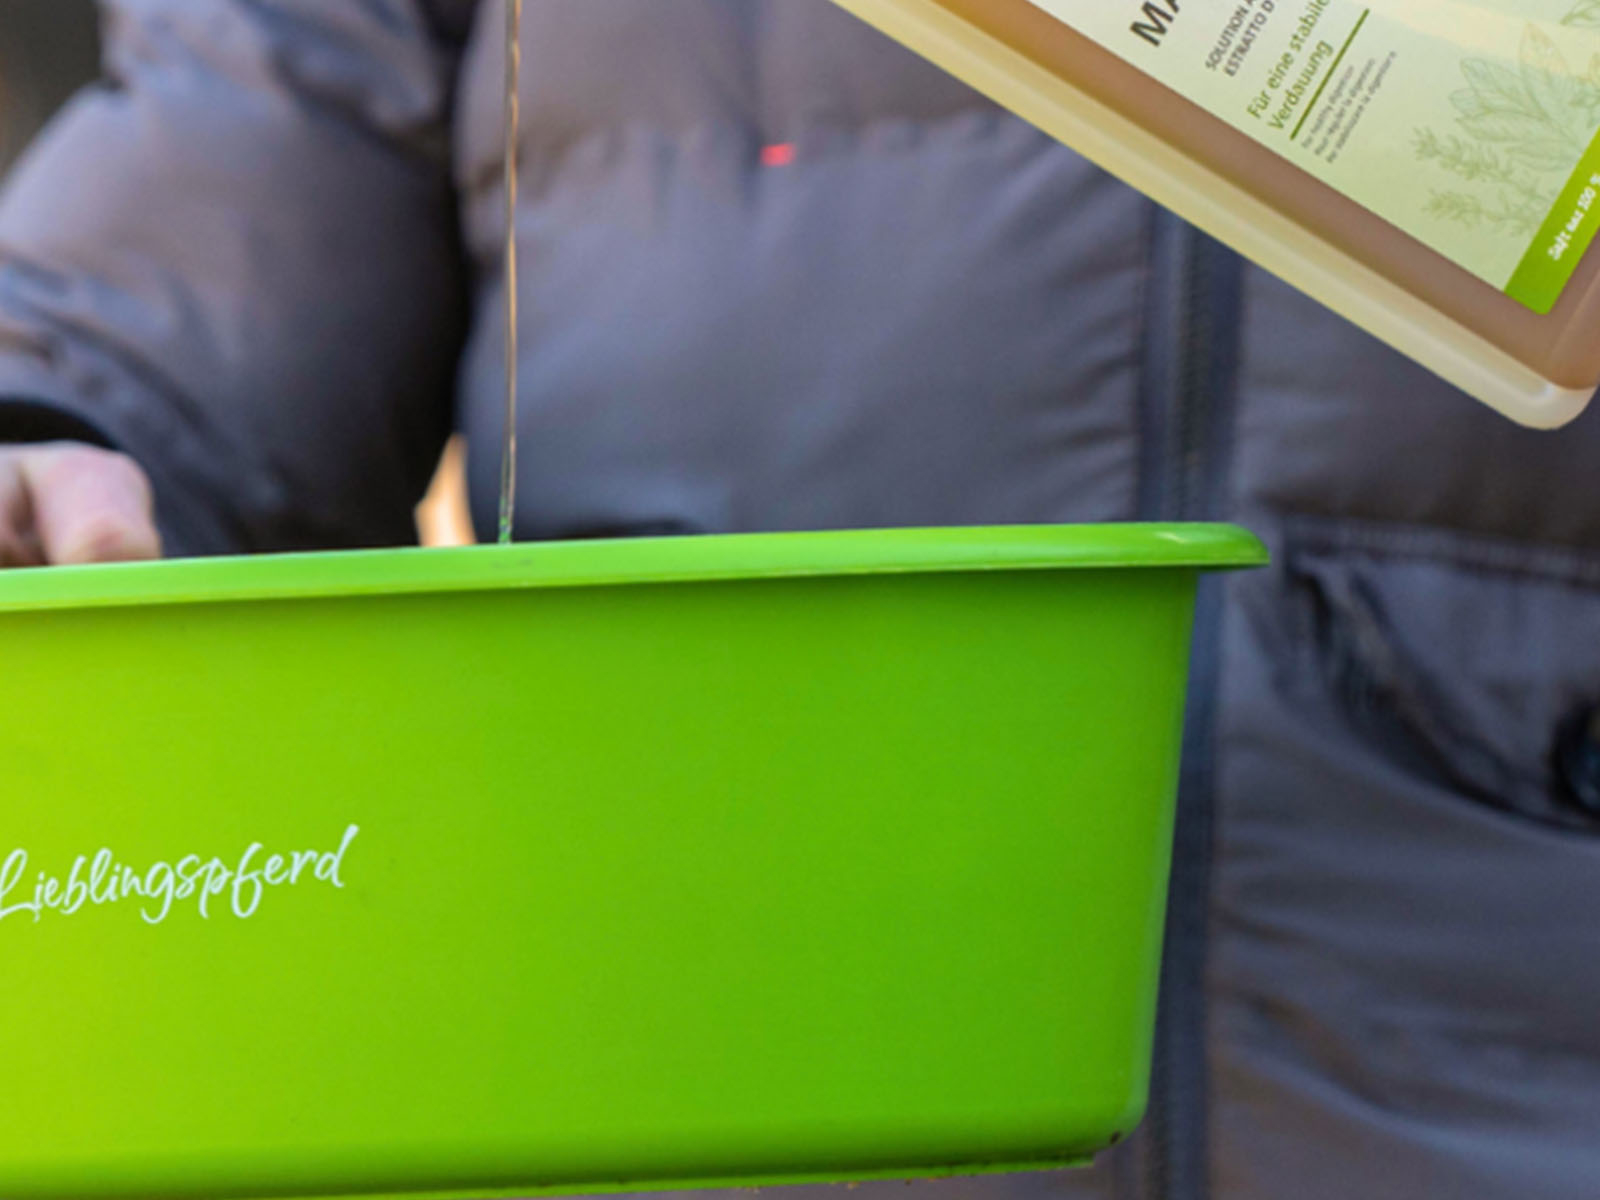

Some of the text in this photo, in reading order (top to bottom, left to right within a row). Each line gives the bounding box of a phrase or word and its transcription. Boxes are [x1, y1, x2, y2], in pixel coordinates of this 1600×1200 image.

[1204, 5, 1249, 70] SOLUTION
[1223, 11, 1267, 77] ESTRATTO
[1246, 89, 1271, 119] Für
[1266, 51, 1294, 89] eine
[1266, 39, 1334, 130] Verdauung
[0, 823, 359, 924] Lieblingspferd
